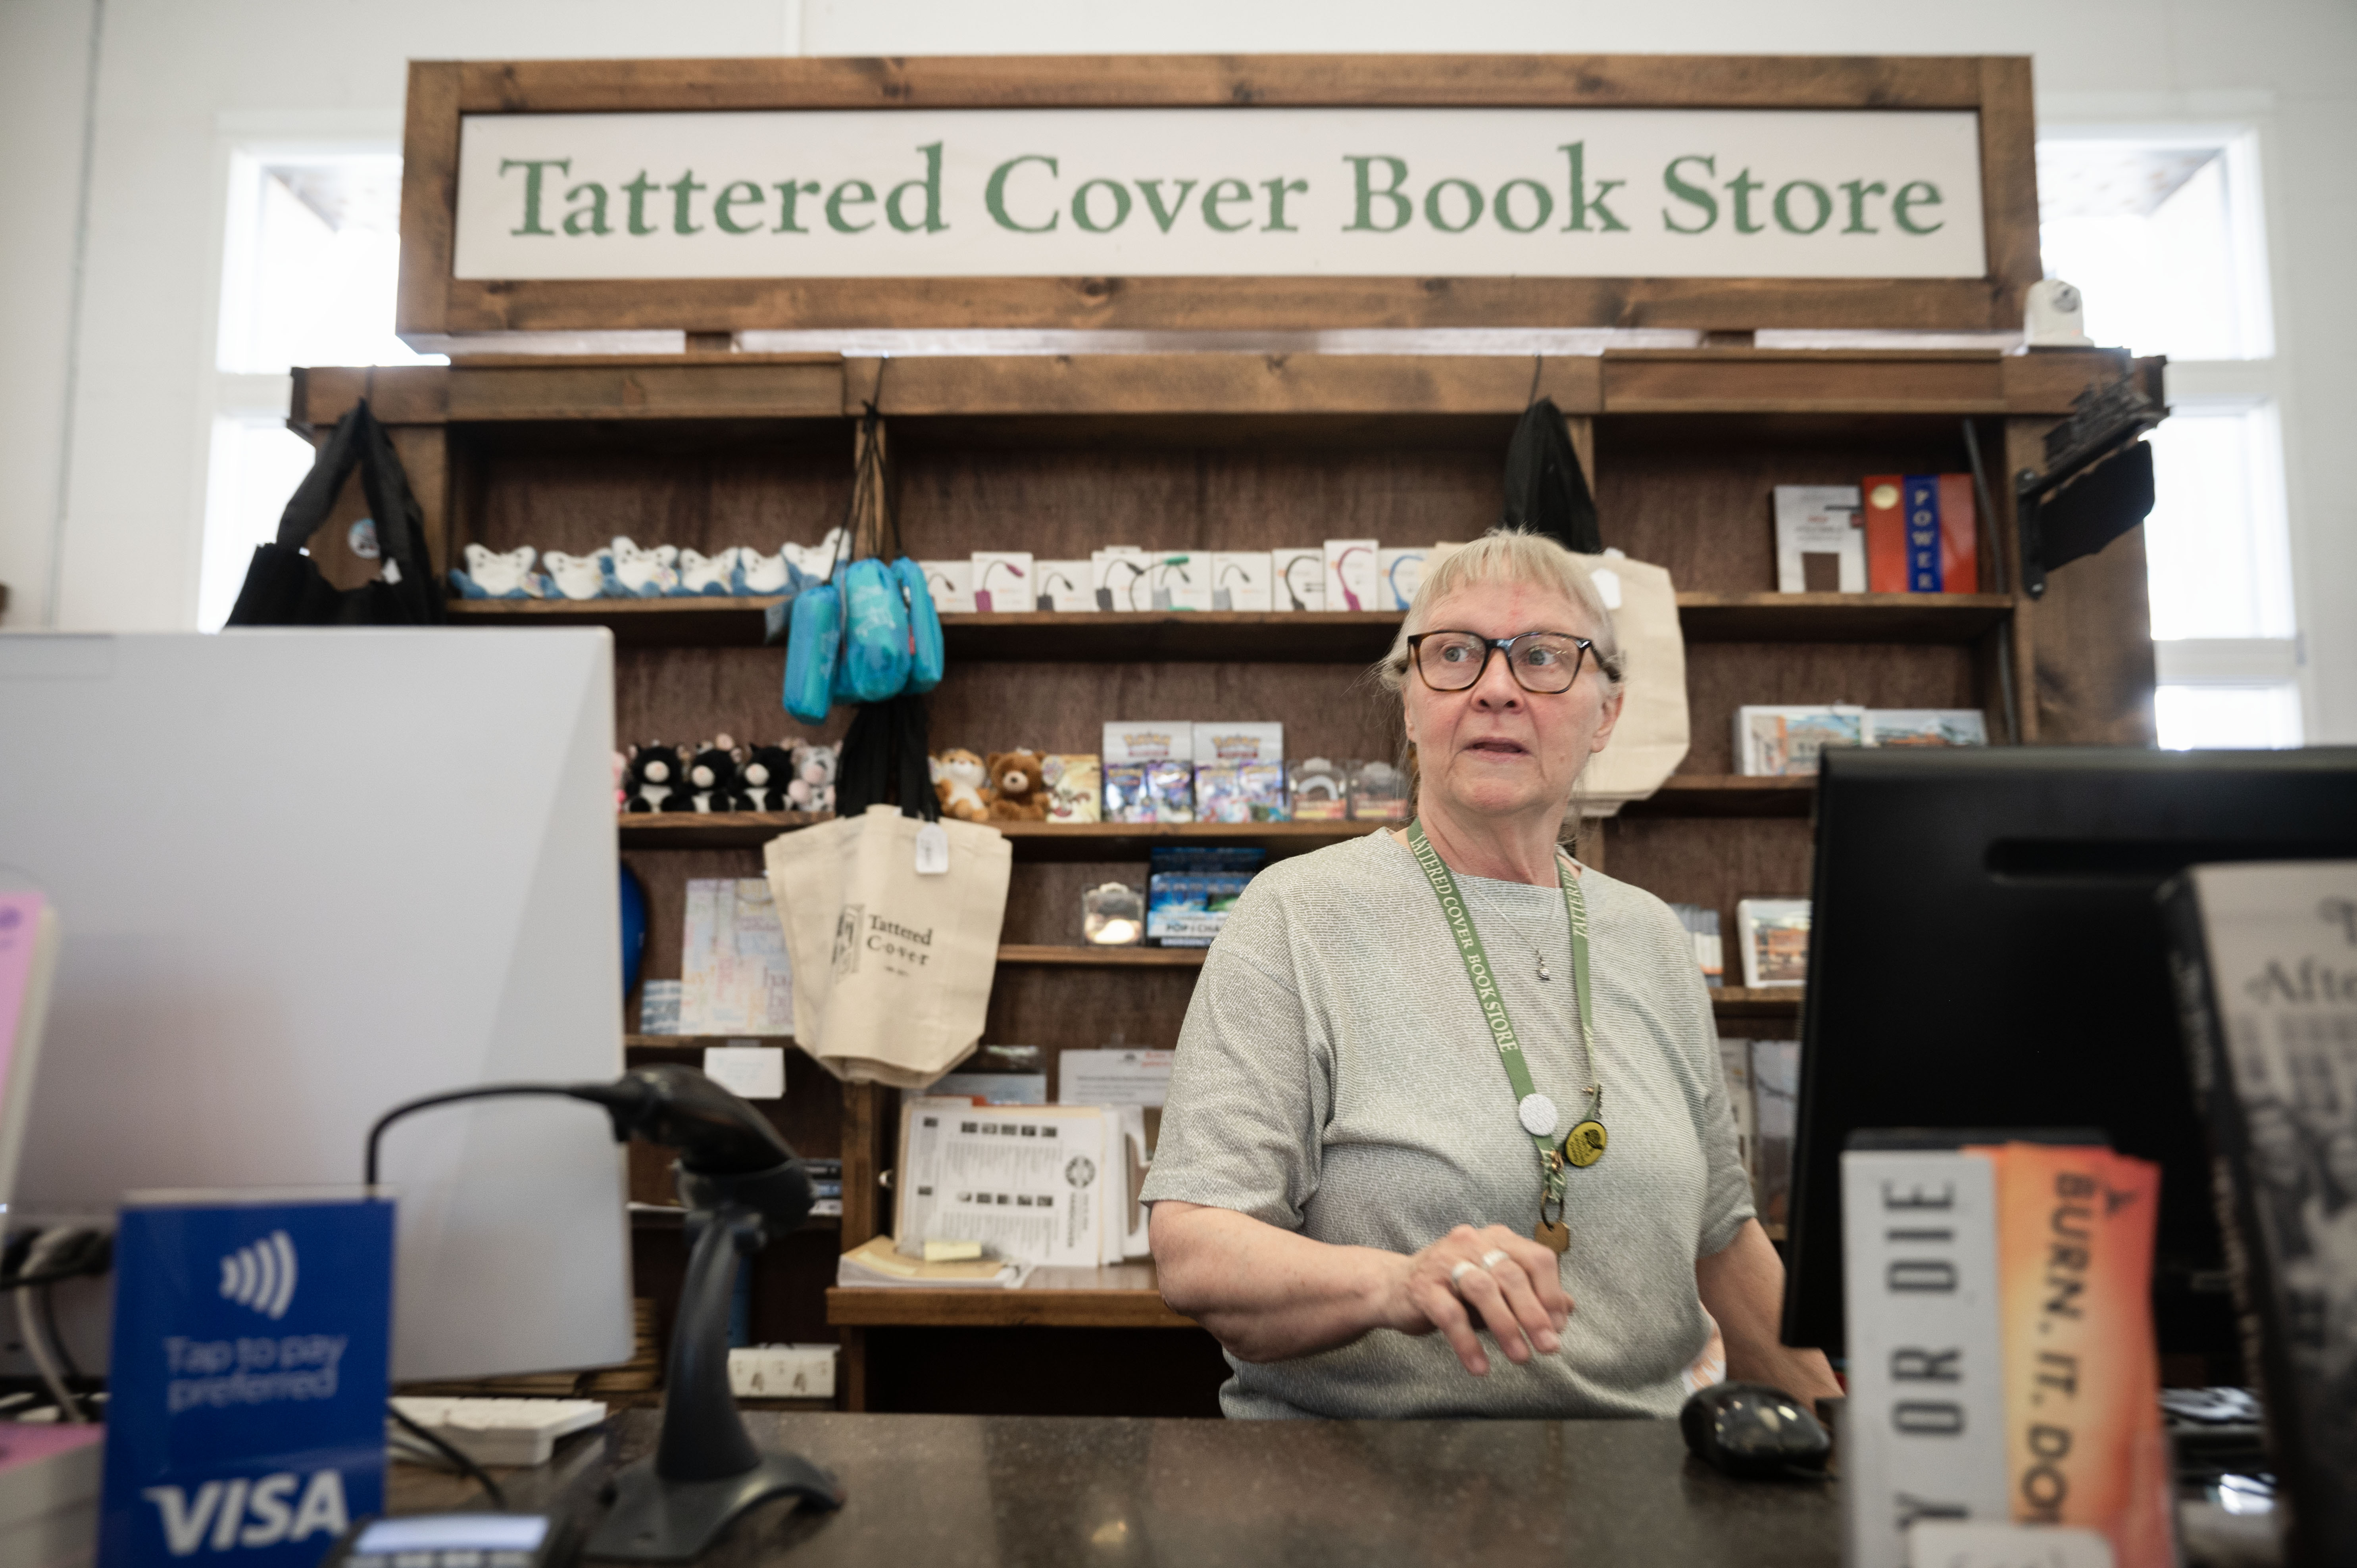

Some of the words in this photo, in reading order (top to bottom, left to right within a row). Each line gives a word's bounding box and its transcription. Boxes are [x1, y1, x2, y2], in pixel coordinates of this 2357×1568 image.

[499, 140, 950, 236] Tattered
[984, 154, 1308, 236] Cover
[1341, 140, 1629, 234] Book
[1662, 154, 1944, 235] Store
[1913, 489, 1934, 590] POWER
[869, 914, 933, 947] Tattered
[1410, 831, 1452, 894] TATTERED
[1443, 896, 1473, 949] COVER
[1467, 953, 1497, 999] BOOK
[1484, 1001, 1519, 1053] STORE
[1882, 1180, 1959, 1294] DIE
[2040, 1172, 2096, 1335] BURN.
[164, 1336, 233, 1375] Tap
[236, 1337, 277, 1370] to
[279, 1334, 348, 1372] pay
[167, 1367, 339, 1415] preferred
[1890, 1348, 1967, 1437] OR
[2030, 1351, 2078, 1407] IT.
[142, 1469, 348, 1557] VISA
